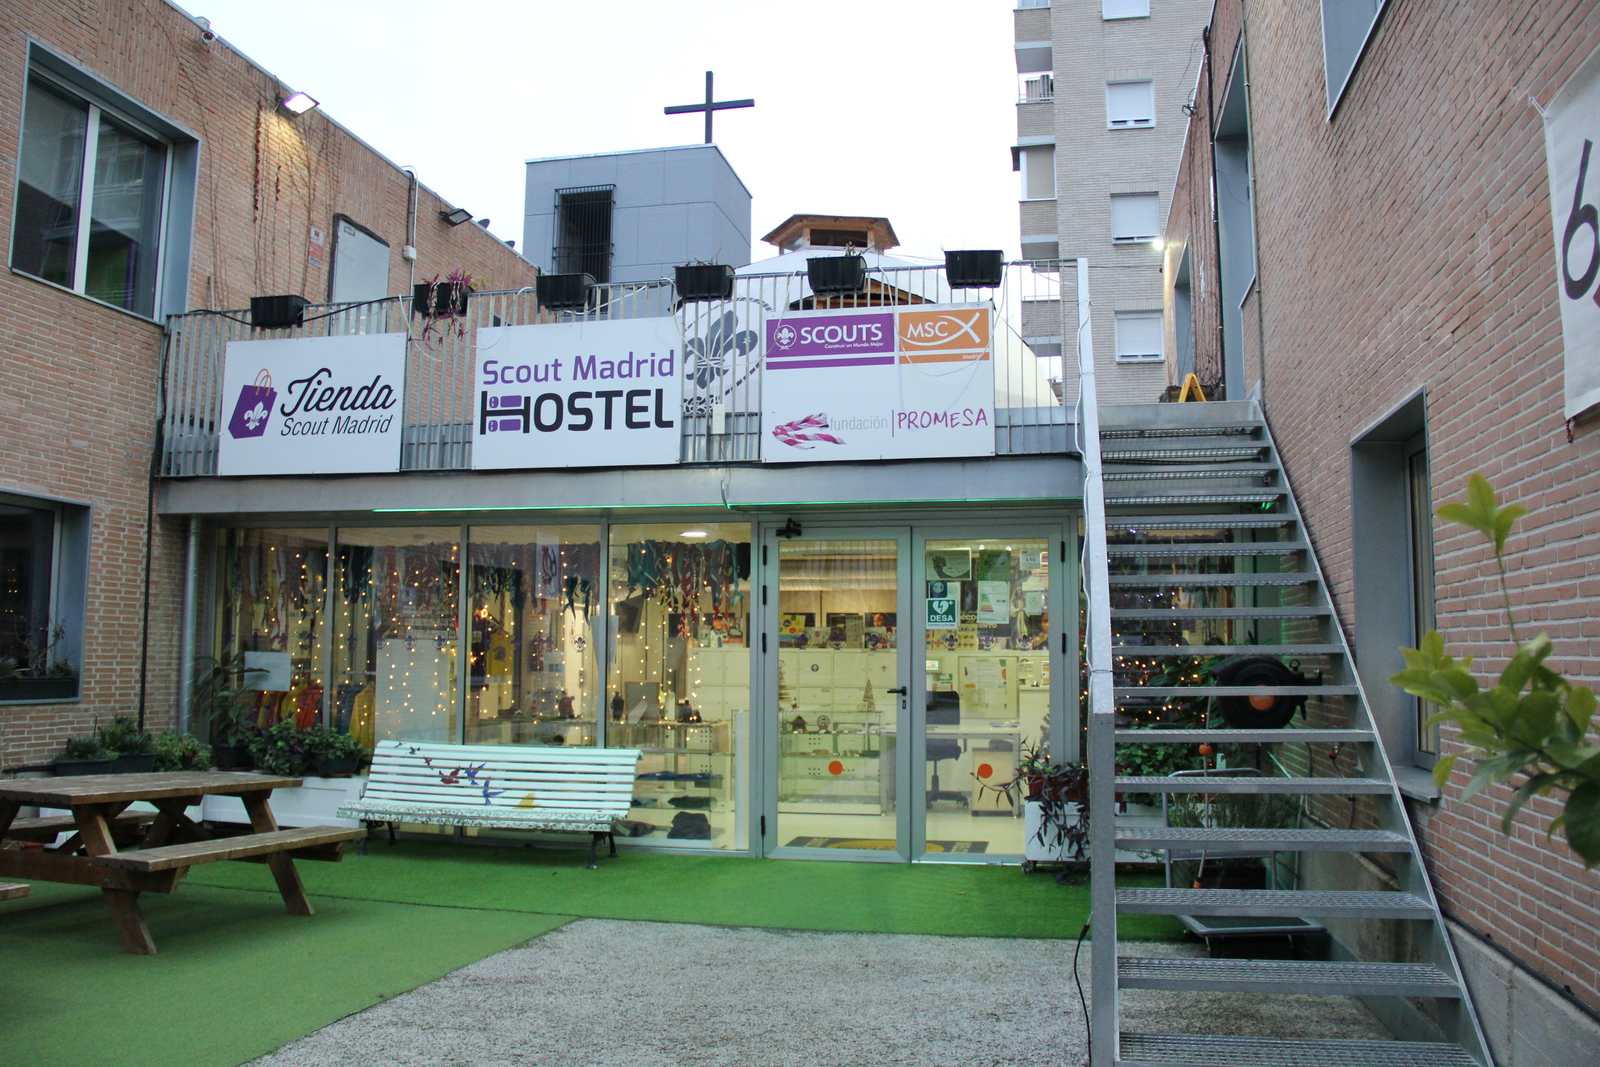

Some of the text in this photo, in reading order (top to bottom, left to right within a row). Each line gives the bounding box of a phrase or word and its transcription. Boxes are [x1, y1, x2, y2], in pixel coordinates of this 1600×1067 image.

[800, 323, 883, 345] SCOUTS
[906, 321, 948, 338] MSC
[482, 349, 675, 386] Scout Madrid
[280, 367, 397, 417] Tienda
[480, 388, 674, 435] HOSTEL
[829, 408, 988, 432] fundación PROMESA
[280, 414, 394, 437] Scout Madrid
[929, 614, 954, 622] DESA
